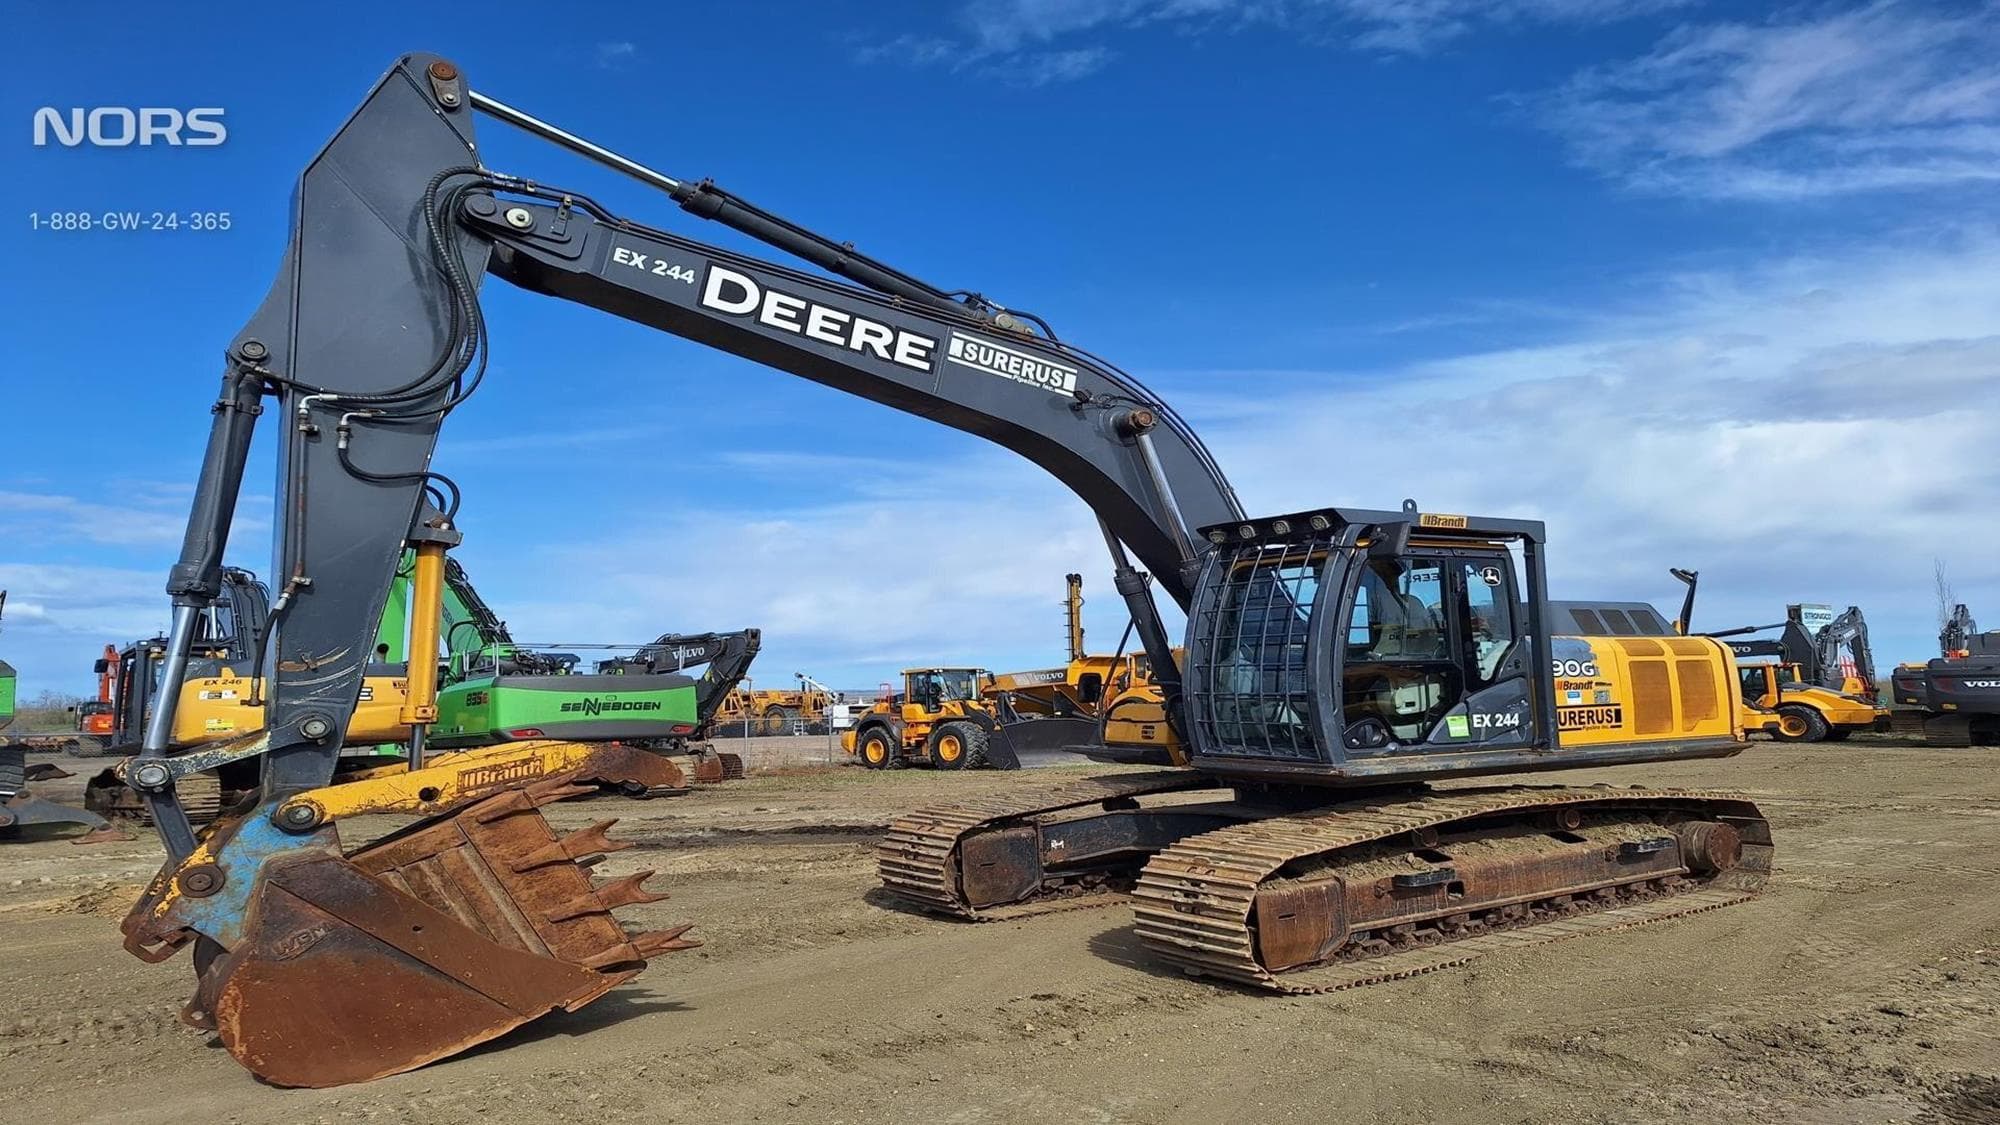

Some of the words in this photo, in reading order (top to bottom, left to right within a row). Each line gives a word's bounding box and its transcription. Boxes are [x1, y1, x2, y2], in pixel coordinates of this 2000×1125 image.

[613, 247, 648, 269] EX
[652, 259, 695, 284] 244
[702, 265, 935, 371] DEERE
[964, 342, 1064, 388] SURERUS
[1430, 515, 1464, 527] Brandt
[672, 646, 705, 660] VOLVO
[1034, 672, 1064, 681] VOLVO
[1563, 680, 1593, 691] Brandt
[560, 698, 661, 716] SENNEBOGEN
[1472, 714, 1492, 728] EX
[1495, 712, 1519, 727] 244
